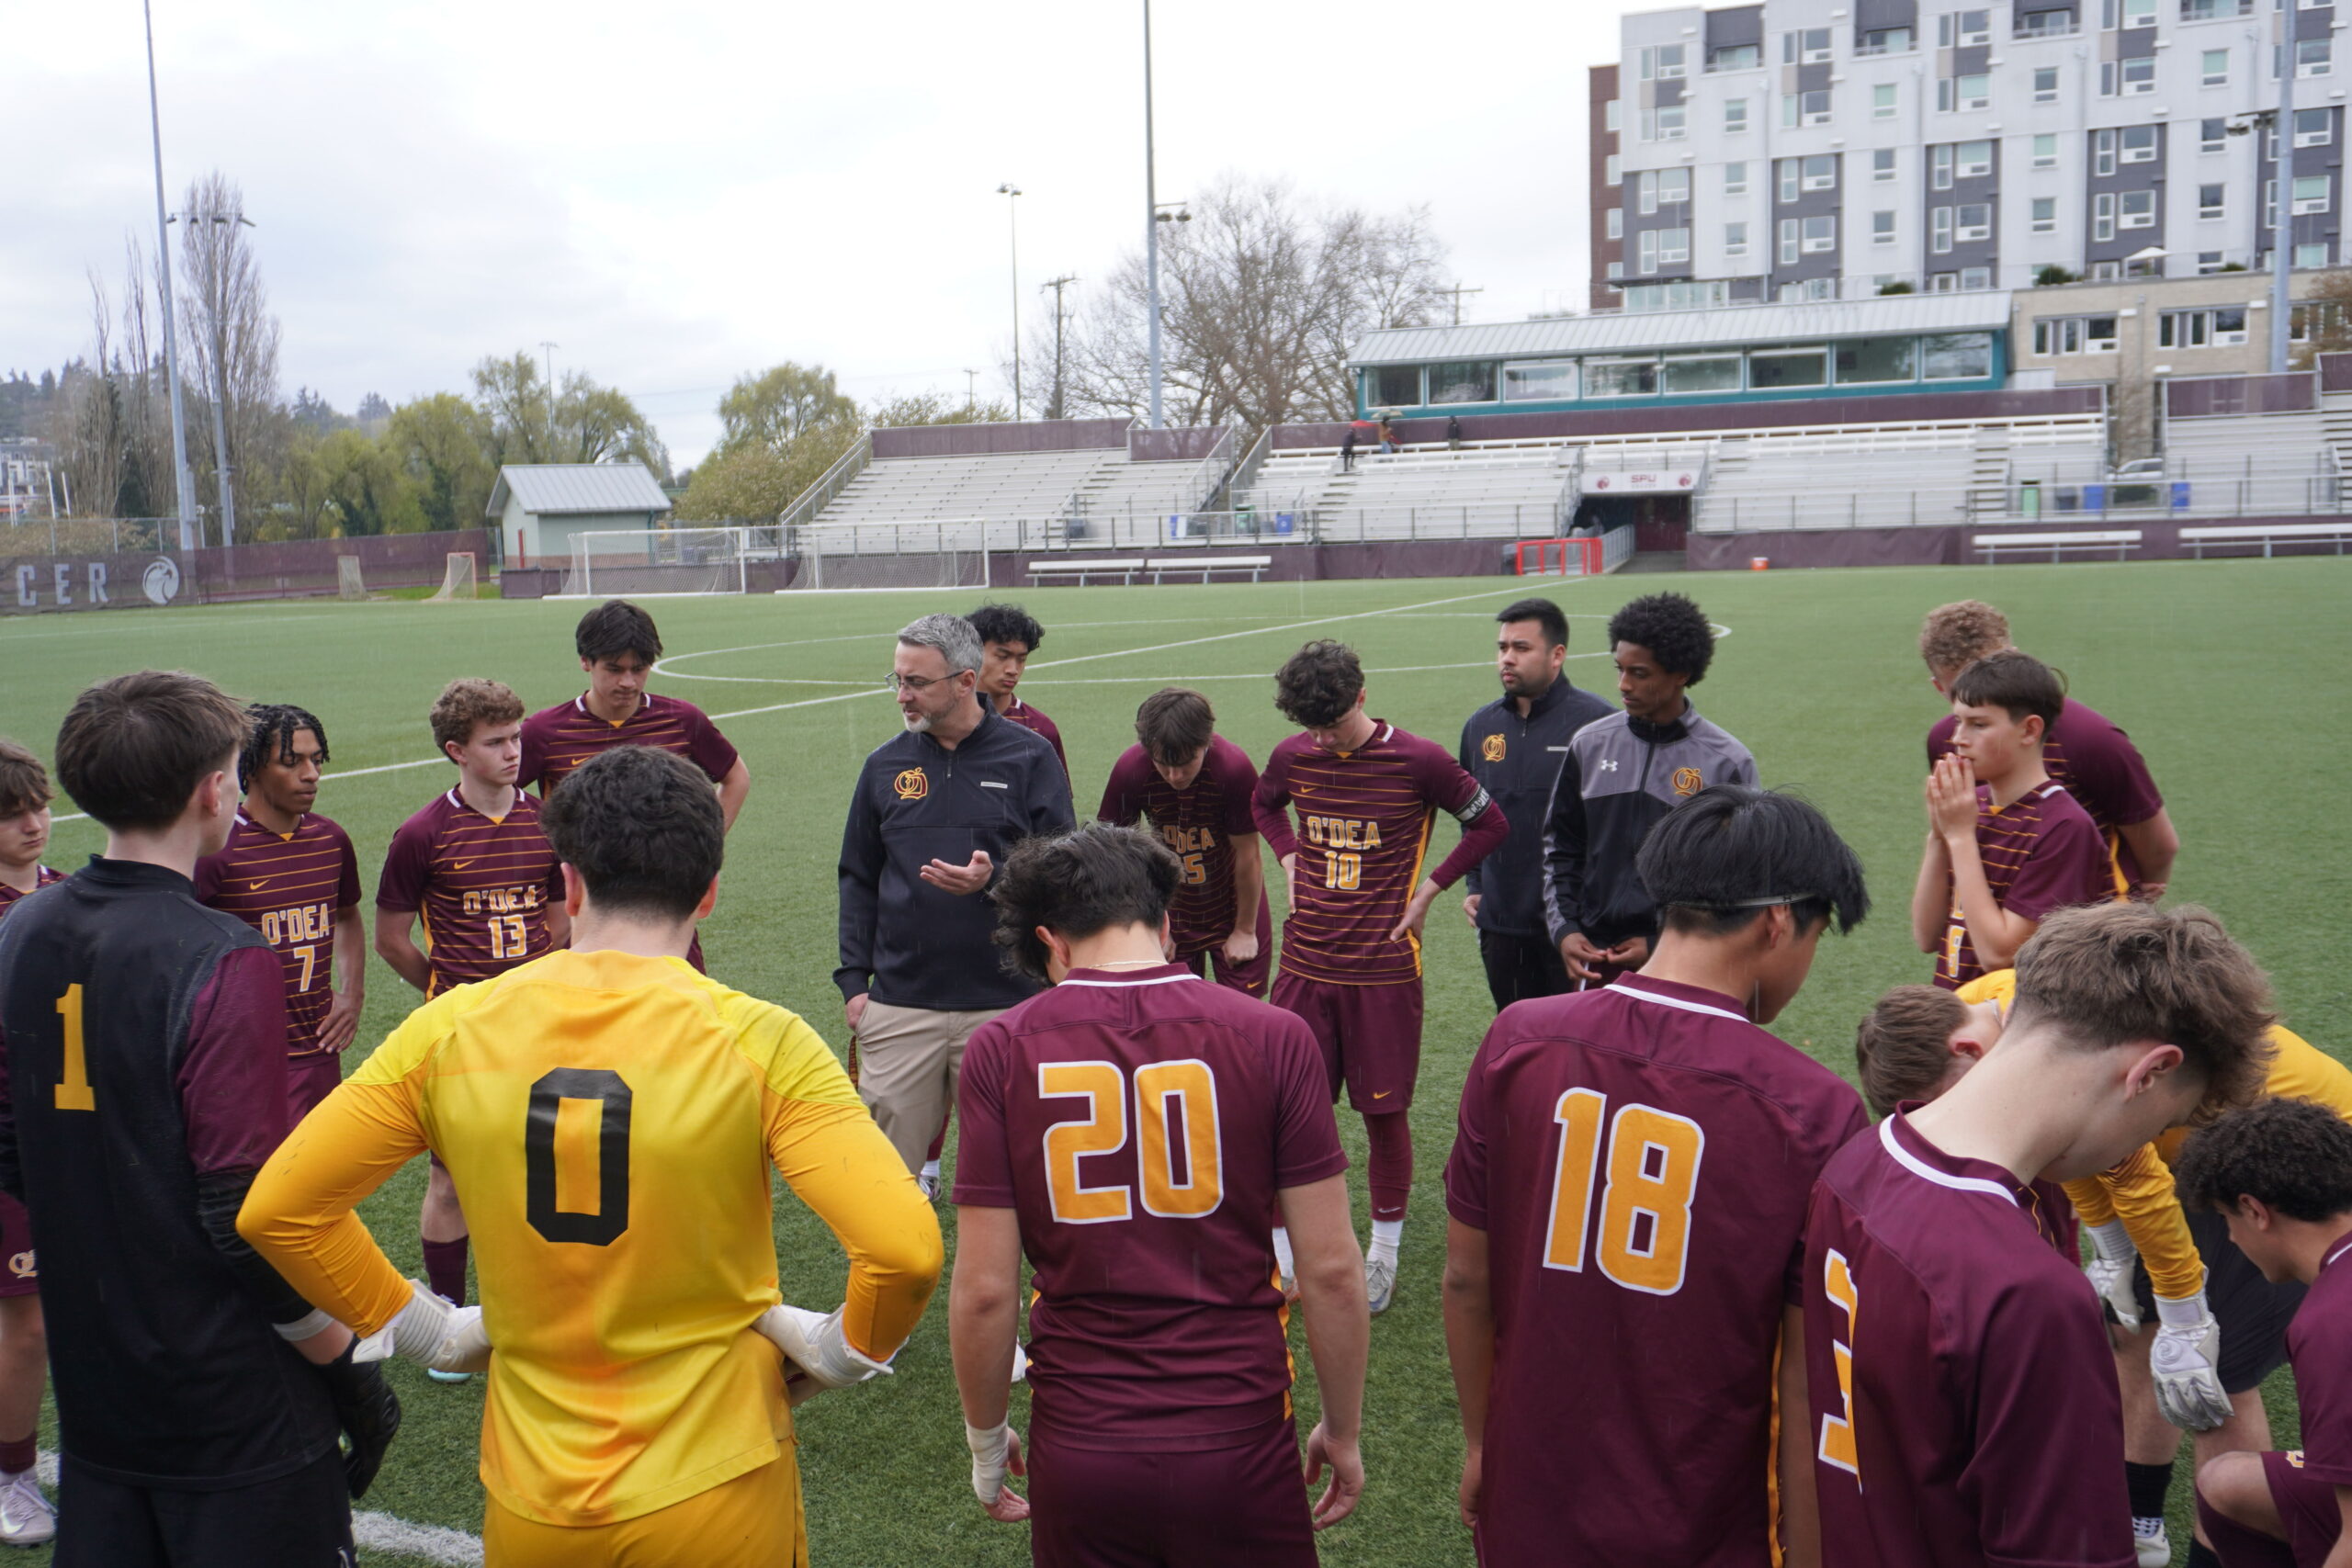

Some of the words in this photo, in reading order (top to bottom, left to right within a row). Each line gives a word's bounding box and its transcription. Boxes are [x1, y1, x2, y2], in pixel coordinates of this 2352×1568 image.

[1630, 474, 1657, 484] SPU
[16, 562, 109, 606] CER
[1306, 815, 1382, 851] O'DEA
[1324, 850, 1362, 891] 10
[462, 885, 540, 916] O'DEA
[261, 903, 330, 946] O'DEA
[487, 913, 527, 960] 13
[292, 944, 316, 993] 7
[54, 982, 96, 1111] 1
[525, 1066, 634, 1247] 0
[1038, 1058, 1225, 1225] 20
[1542, 1086, 1705, 1297] 18
